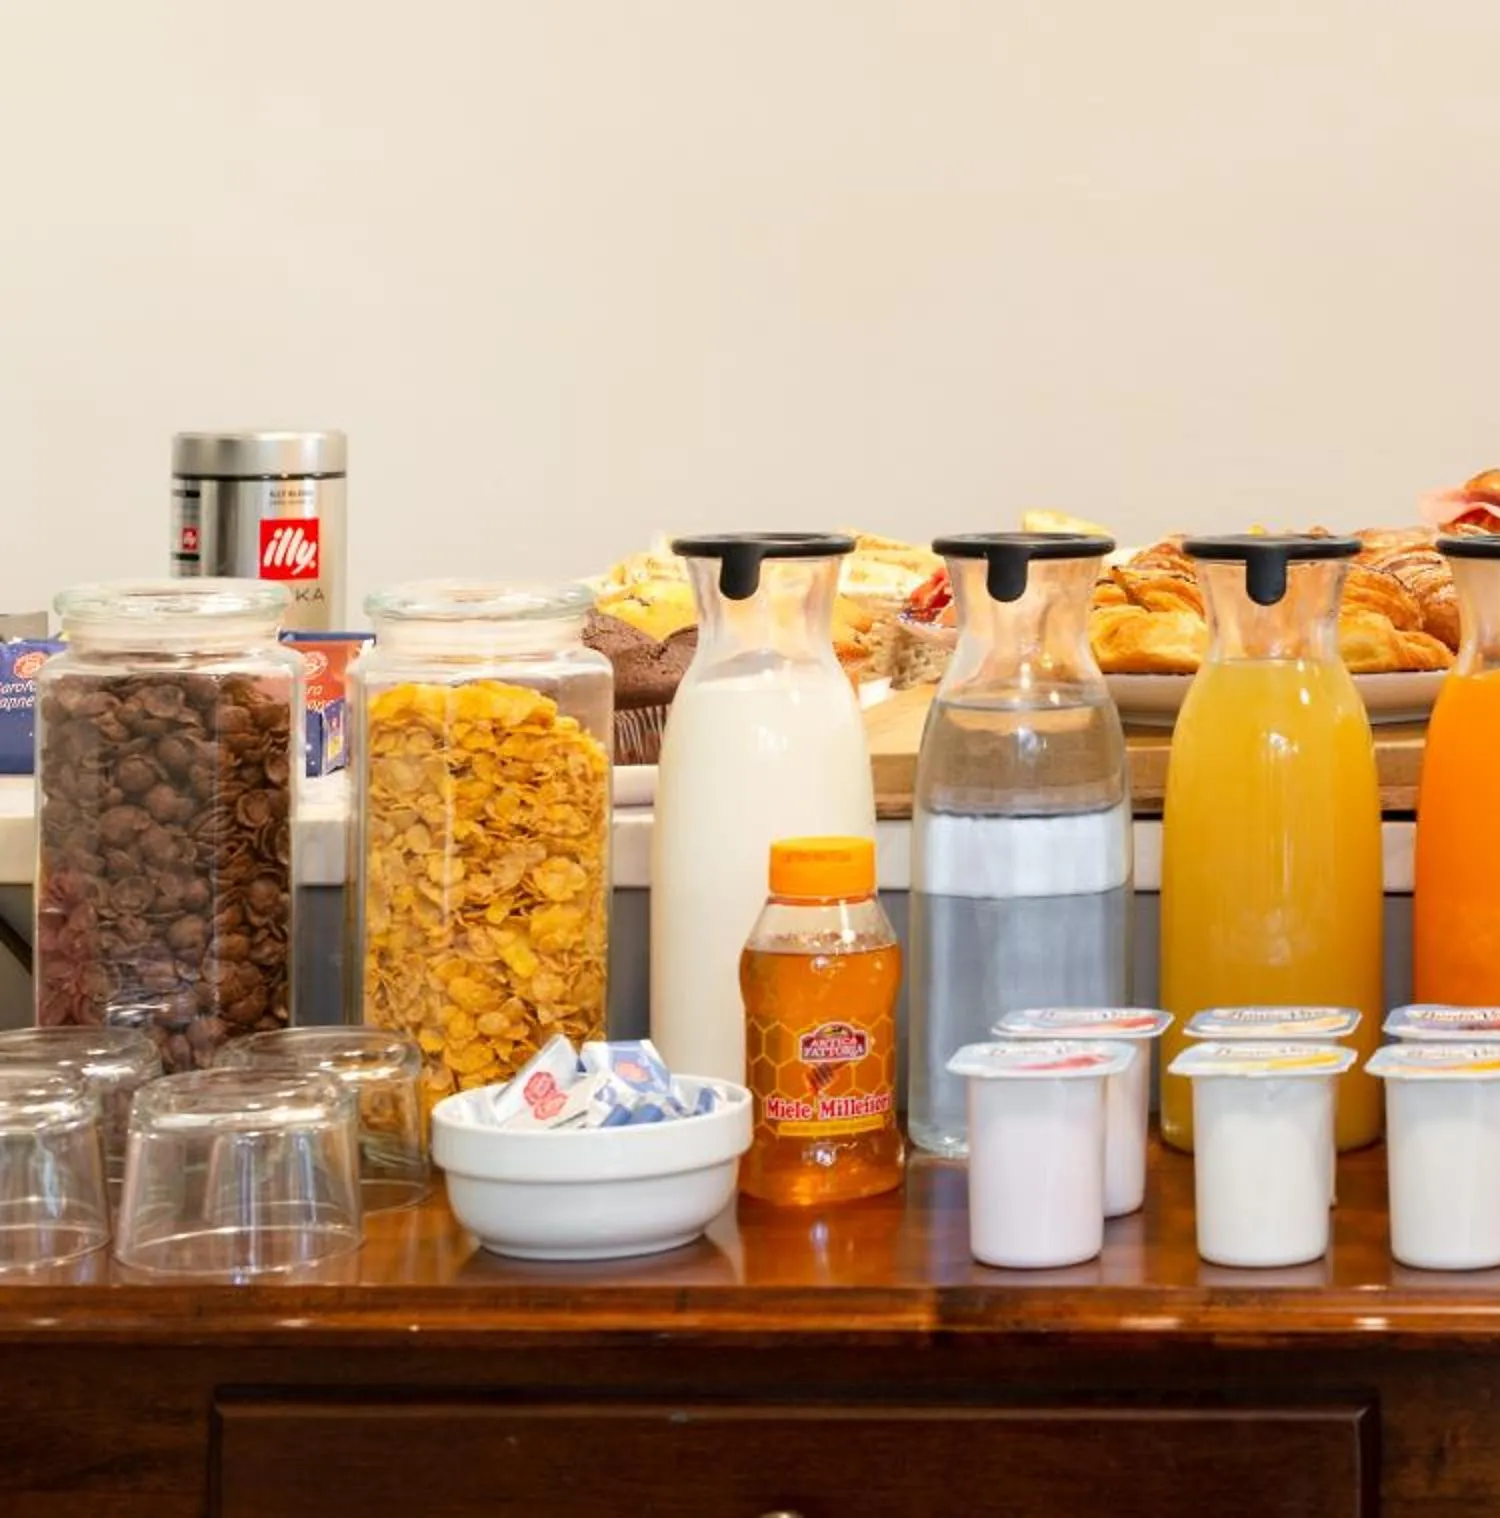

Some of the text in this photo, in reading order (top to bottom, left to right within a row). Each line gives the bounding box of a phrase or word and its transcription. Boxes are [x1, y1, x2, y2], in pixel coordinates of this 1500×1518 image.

[263, 527, 317, 576] illy
[295, 588, 325, 602] KA
[767, 1098, 812, 1119] Miele
